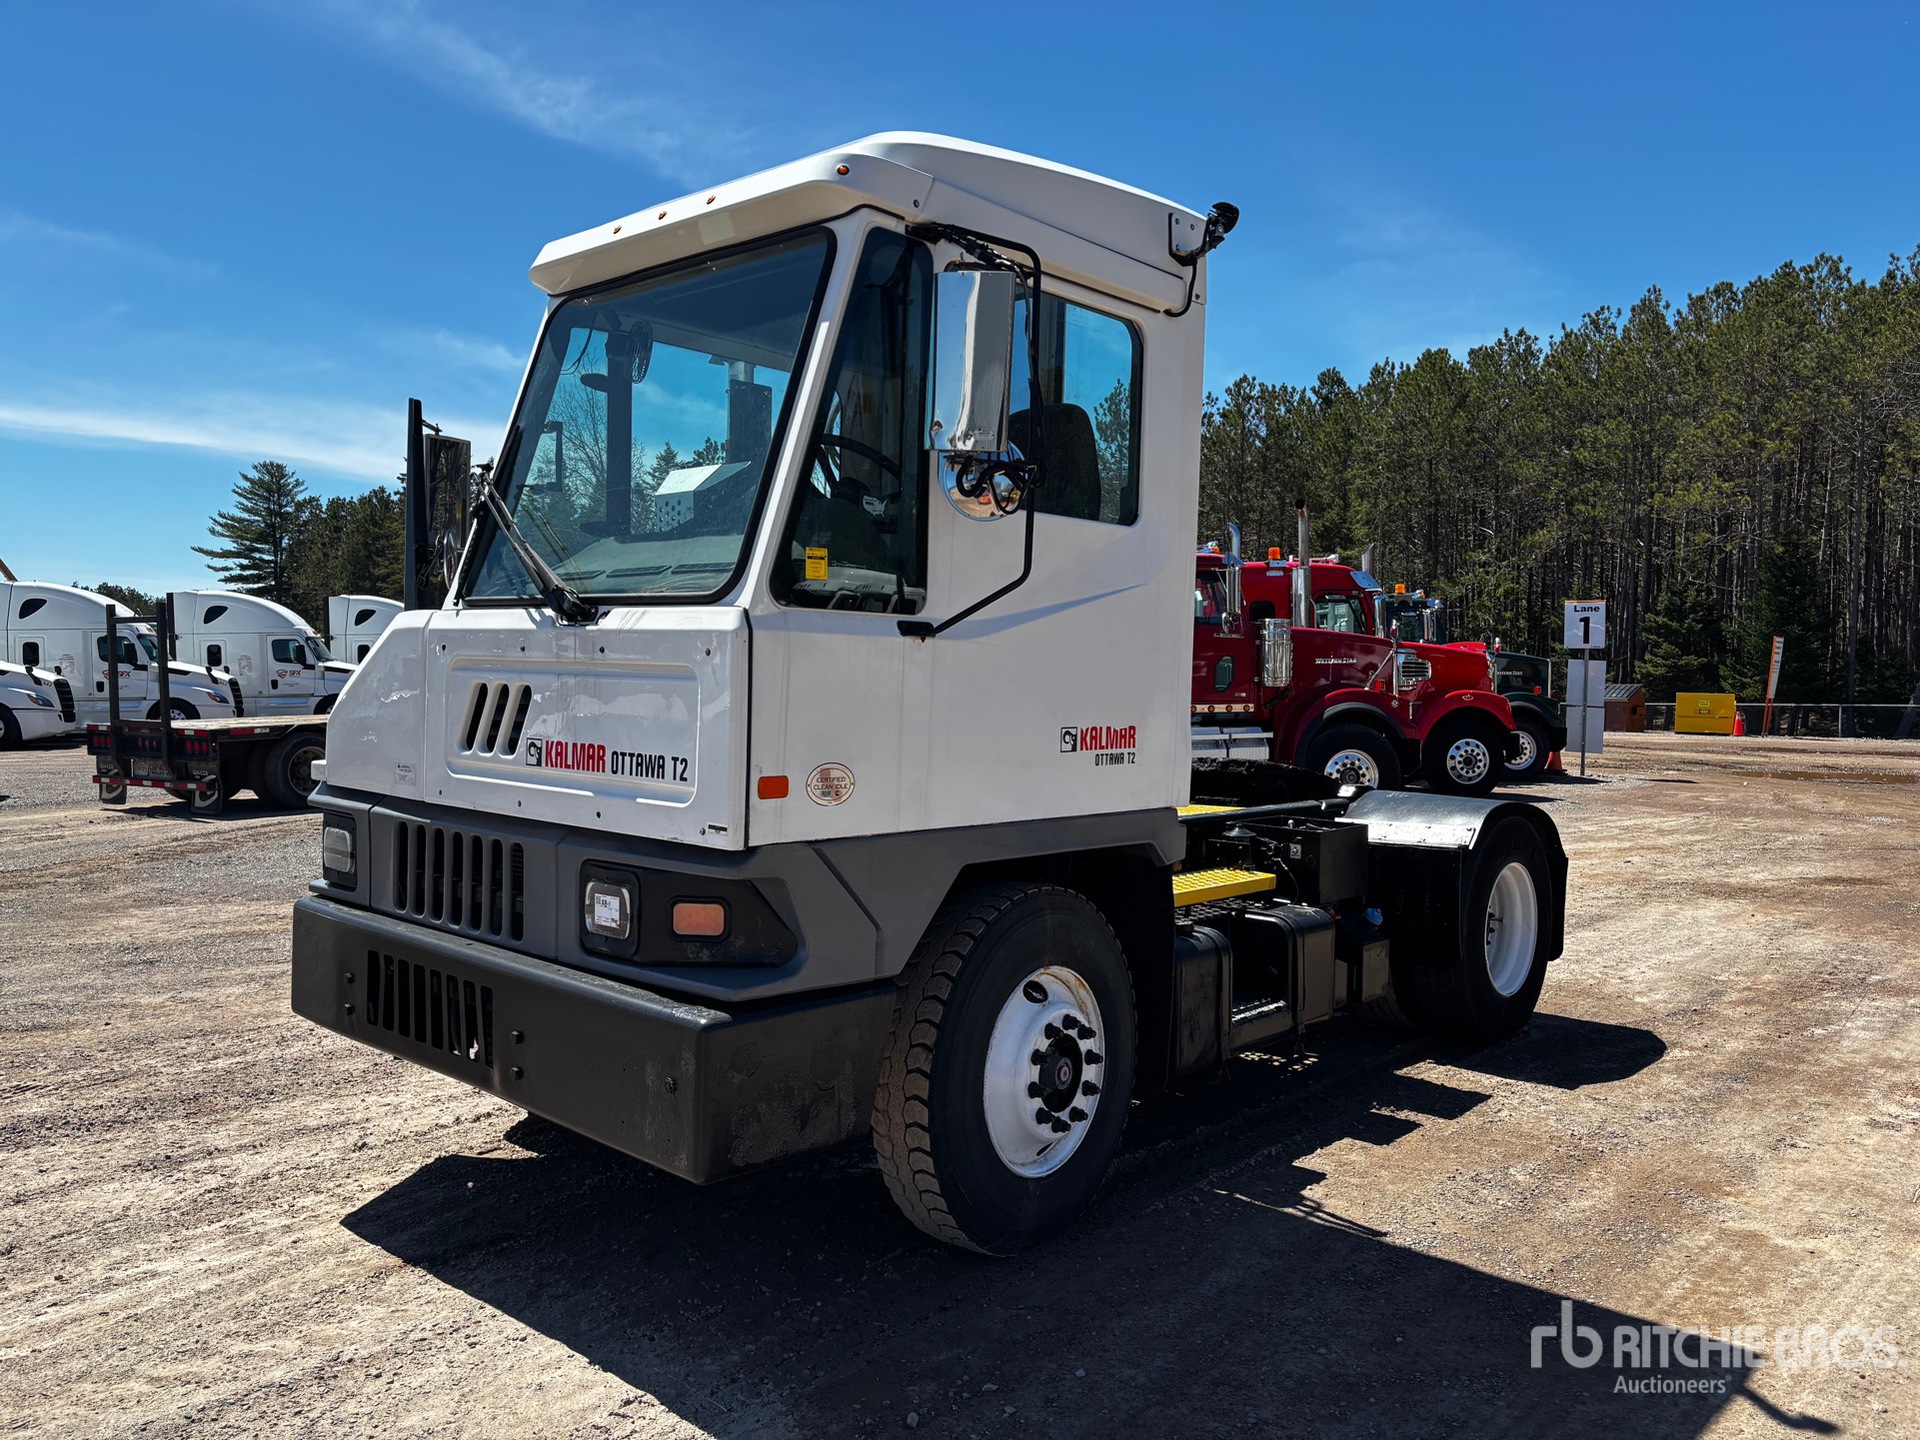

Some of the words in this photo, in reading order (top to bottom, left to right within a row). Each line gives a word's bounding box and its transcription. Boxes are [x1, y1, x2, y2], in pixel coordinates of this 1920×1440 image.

[1573, 604, 1601, 613] Lane
[1578, 616, 1591, 645] 1
[1079, 725, 1137, 751] KALMAR
[544, 739, 607, 774] KALMAR
[610, 750, 666, 780] OTTAWA
[671, 756, 688, 782] T2
[1094, 752, 1125, 766] OTTAWA
[1126, 751, 1136, 764] T2
